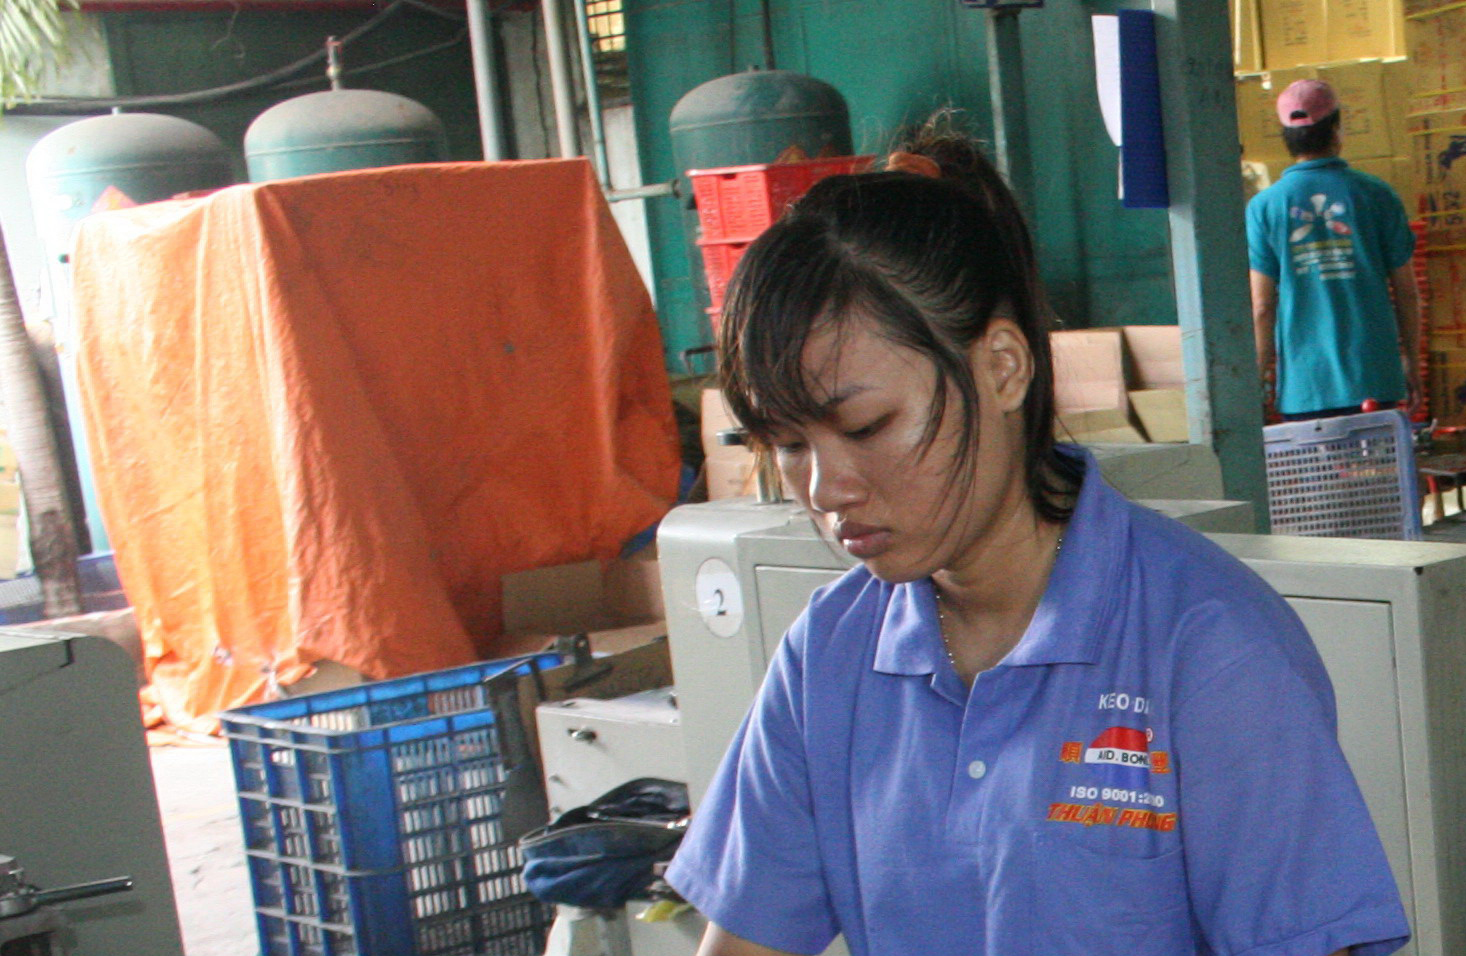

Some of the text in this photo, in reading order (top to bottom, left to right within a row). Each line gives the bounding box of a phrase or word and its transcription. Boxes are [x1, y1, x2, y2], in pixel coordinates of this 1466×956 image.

[713, 588, 728, 616] 2
[1098, 692, 1130, 711] KEO
[1070, 786, 1098, 800] ISO
